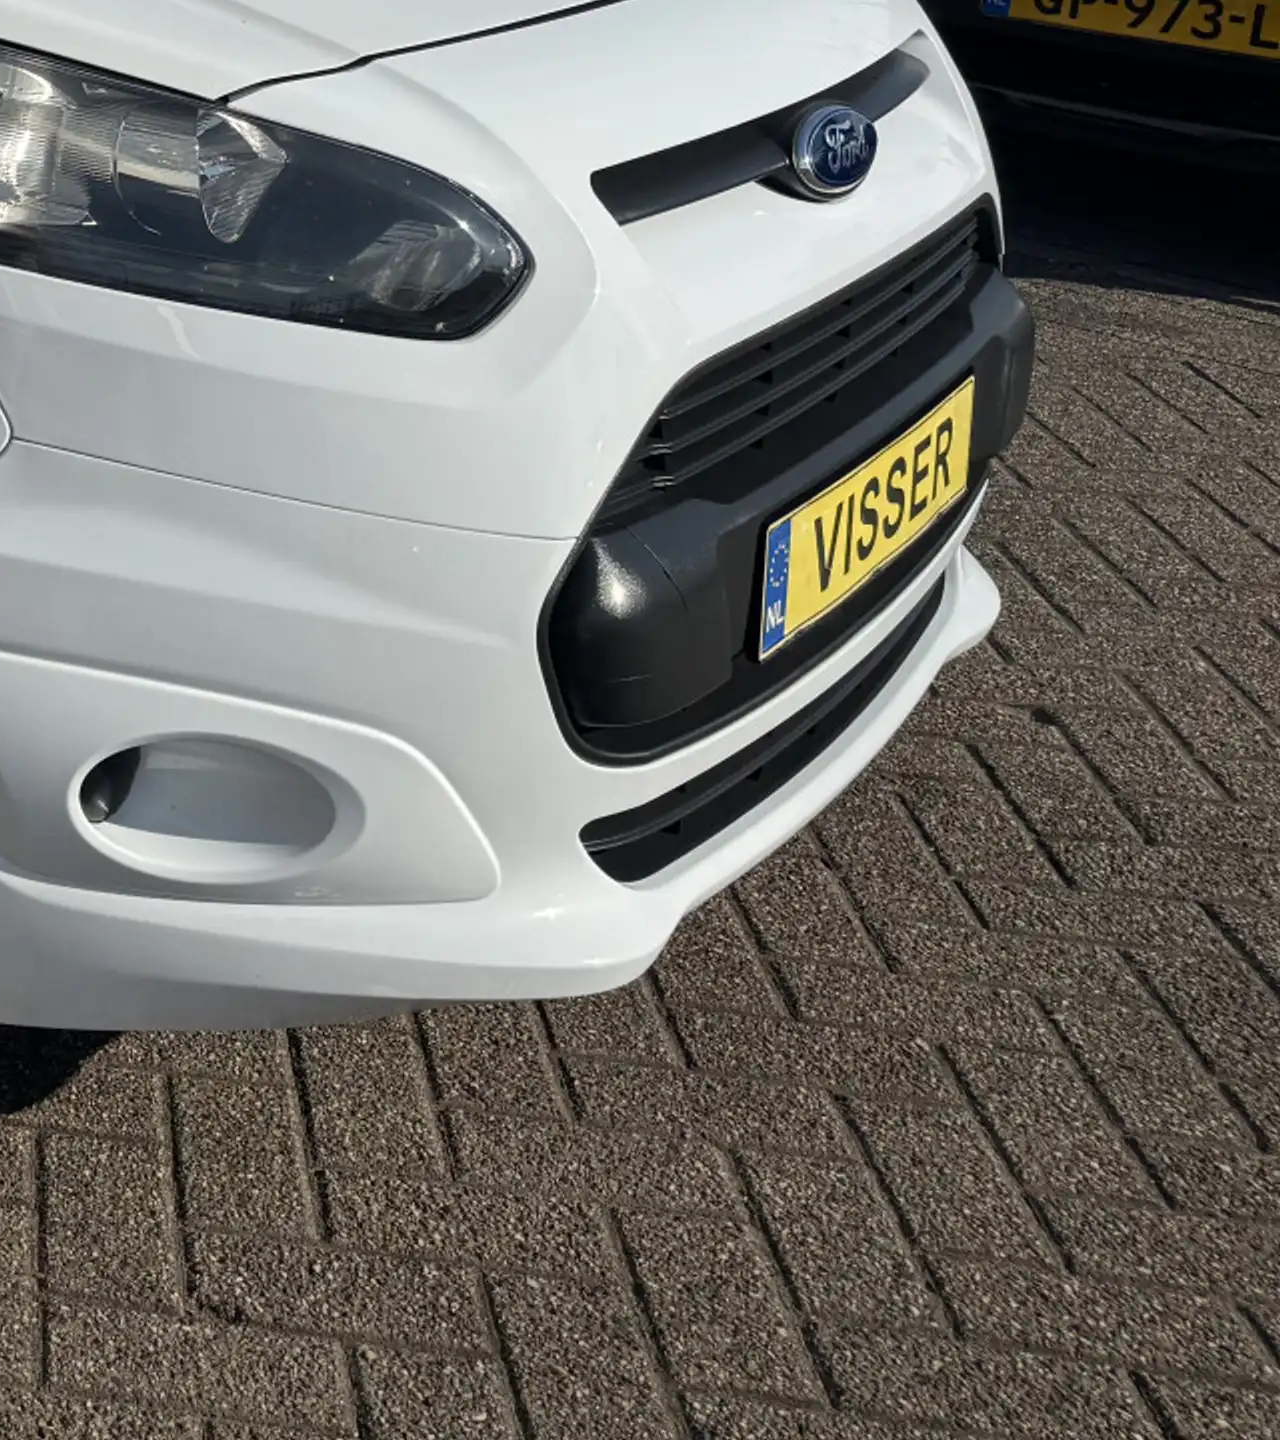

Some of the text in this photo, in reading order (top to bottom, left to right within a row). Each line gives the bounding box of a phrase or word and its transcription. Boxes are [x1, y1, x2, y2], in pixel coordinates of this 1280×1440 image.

[824, 119, 869, 175] Ford
[813, 416, 954, 592] VISSER
[765, 597, 786, 633] NL
